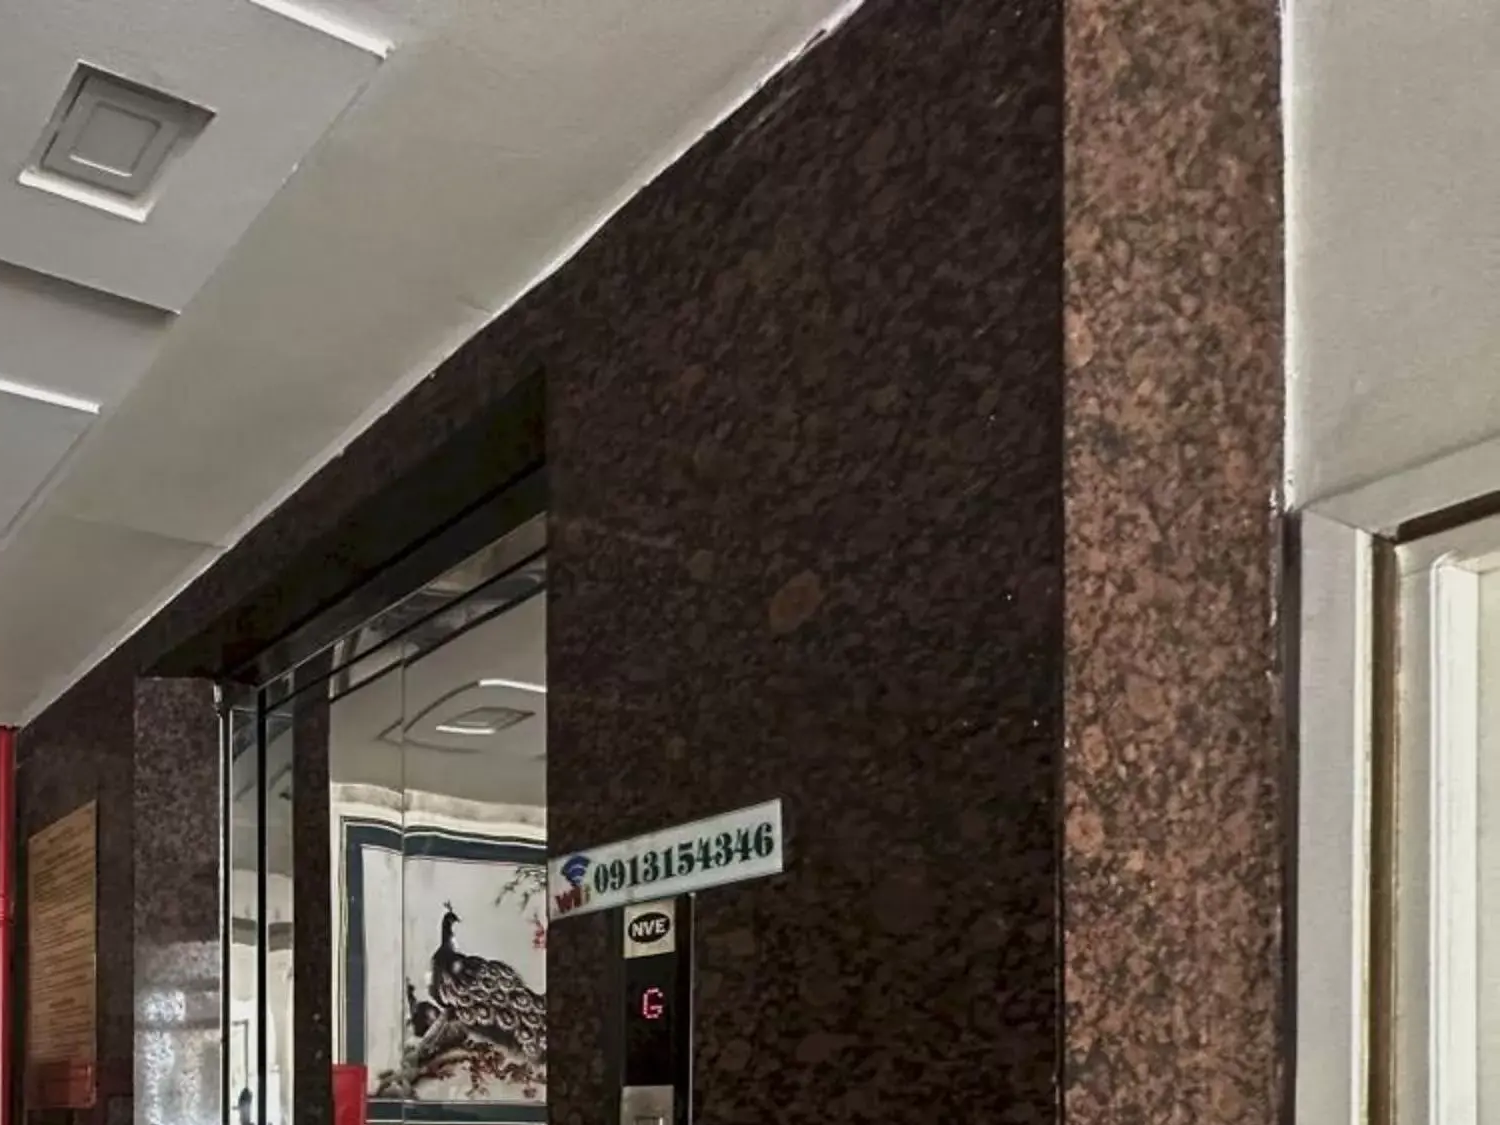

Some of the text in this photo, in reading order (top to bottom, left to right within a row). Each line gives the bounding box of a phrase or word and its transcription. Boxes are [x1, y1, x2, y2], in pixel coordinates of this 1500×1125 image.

[594, 822, 774, 894] 0913154346
[631, 919, 666, 937] NVE
[641, 987, 664, 1019] G
